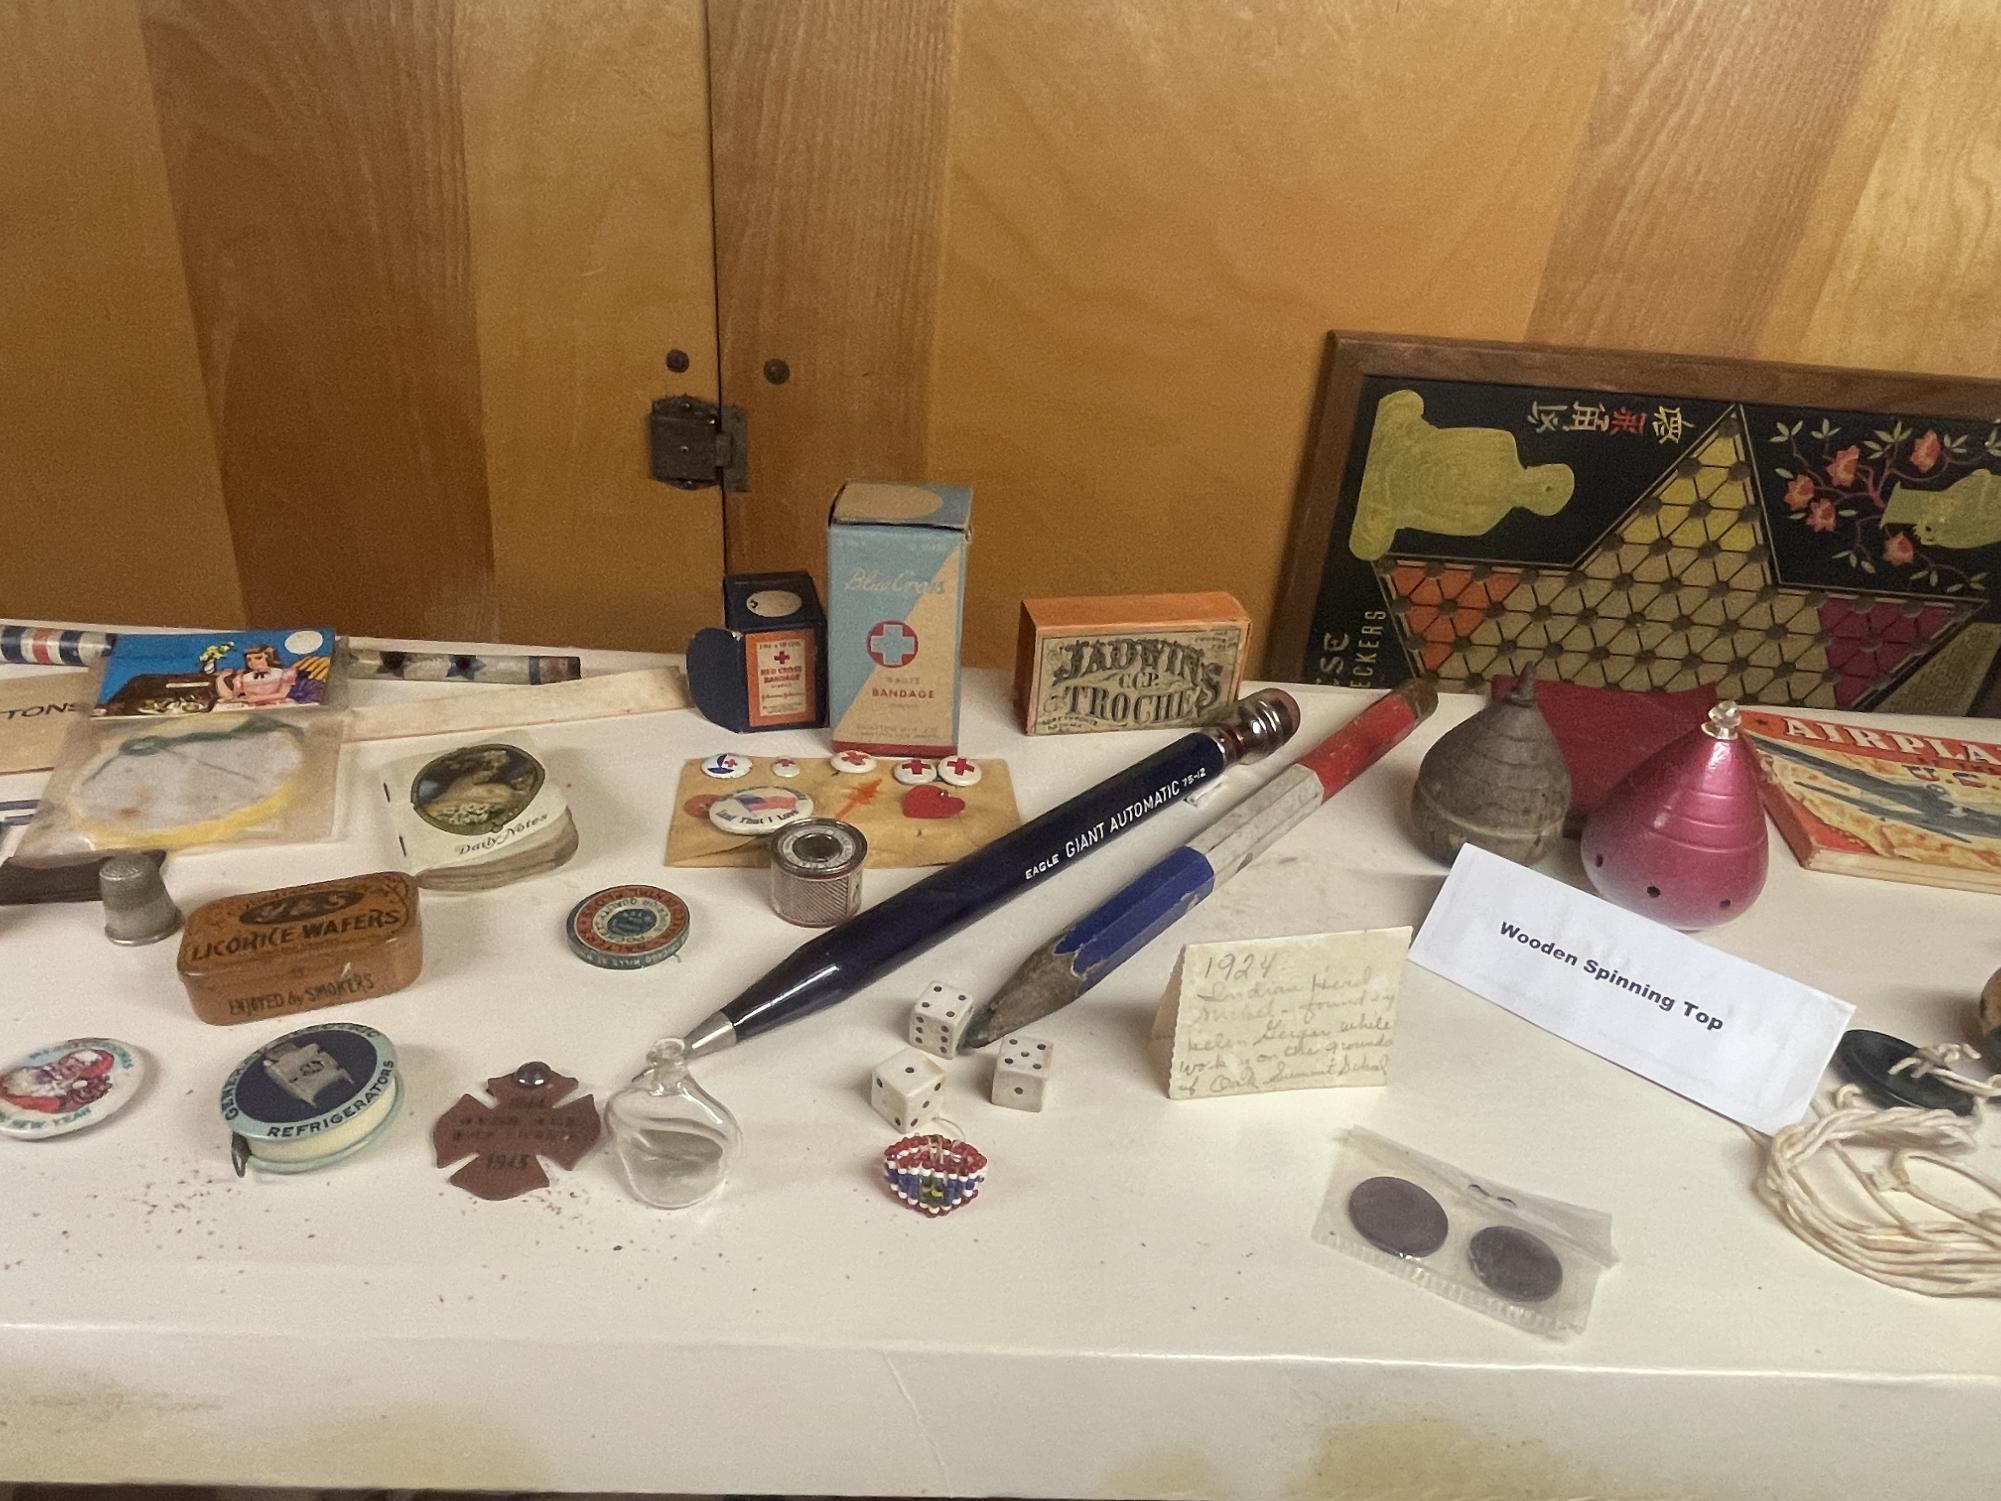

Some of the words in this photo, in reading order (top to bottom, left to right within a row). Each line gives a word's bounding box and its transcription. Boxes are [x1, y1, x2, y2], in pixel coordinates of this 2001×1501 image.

[871, 688, 935, 699] BANDAGE
[454, 836, 497, 856] Daily
[495, 813, 548, 845] Notes
[739, 815, 765, 825] That
[1025, 853, 1060, 880] EAGLE
[1065, 822, 1105, 859] GIANT
[1109, 780, 1181, 834] AUTOMATIC
[1182, 767, 1207, 788] 75-12
[191, 927, 295, 961] LICORICE
[302, 907, 401, 940] WAFERS
[1203, 952, 1279, 981] 1924
[1500, 920, 1579, 967] Wooden
[1582, 958, 1676, 1012] Spinning
[1683, 1000, 1725, 1032] Top
[305, 972, 375, 1002] SMOKERS
[1298, 990, 1368, 1024] found
[1340, 1013, 1392, 1033] while
[265, 1059, 395, 1138] REFRIGERATORS
